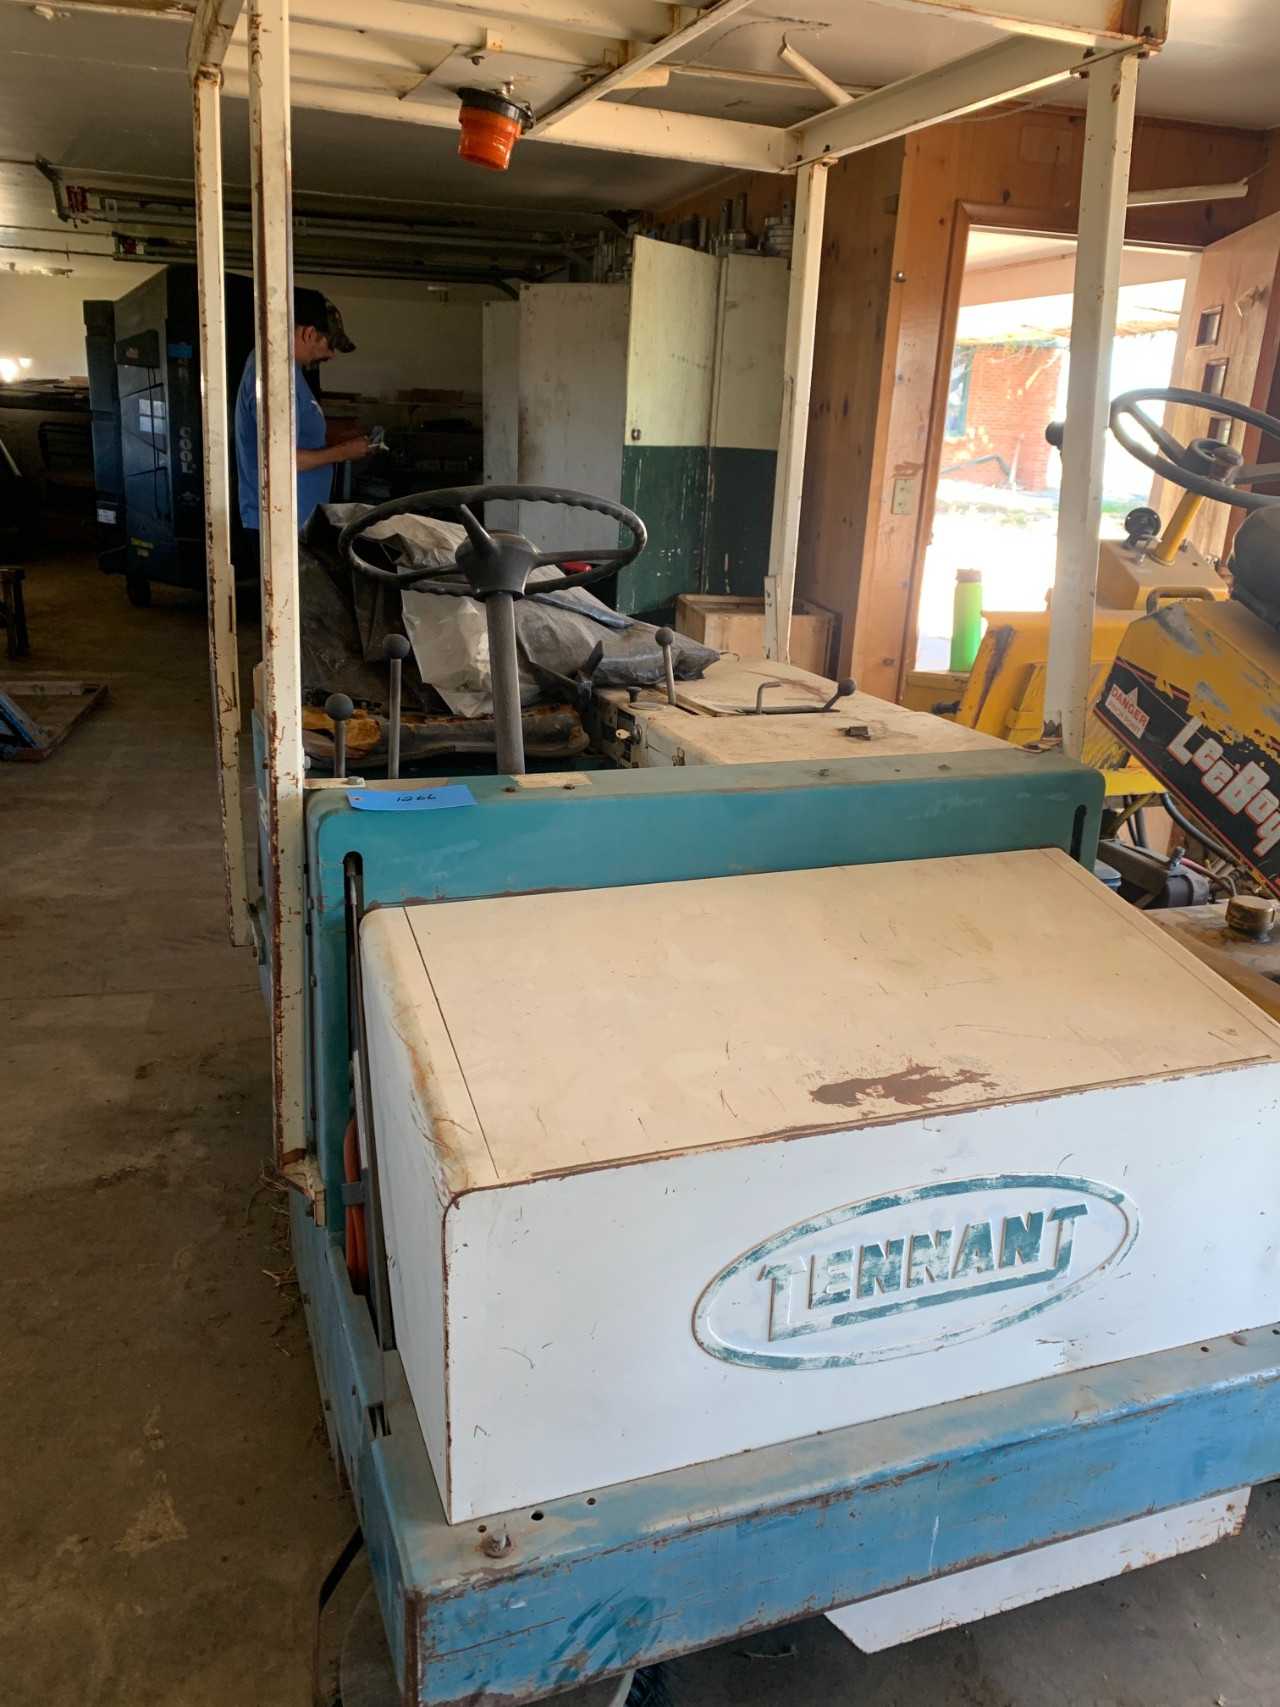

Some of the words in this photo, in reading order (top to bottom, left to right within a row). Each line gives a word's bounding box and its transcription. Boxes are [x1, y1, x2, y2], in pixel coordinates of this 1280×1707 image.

[1111, 688, 1147, 727] DANGER
[1168, 715, 1280, 857] LeeBoy
[757, 1203, 1089, 1341] TENNANT
